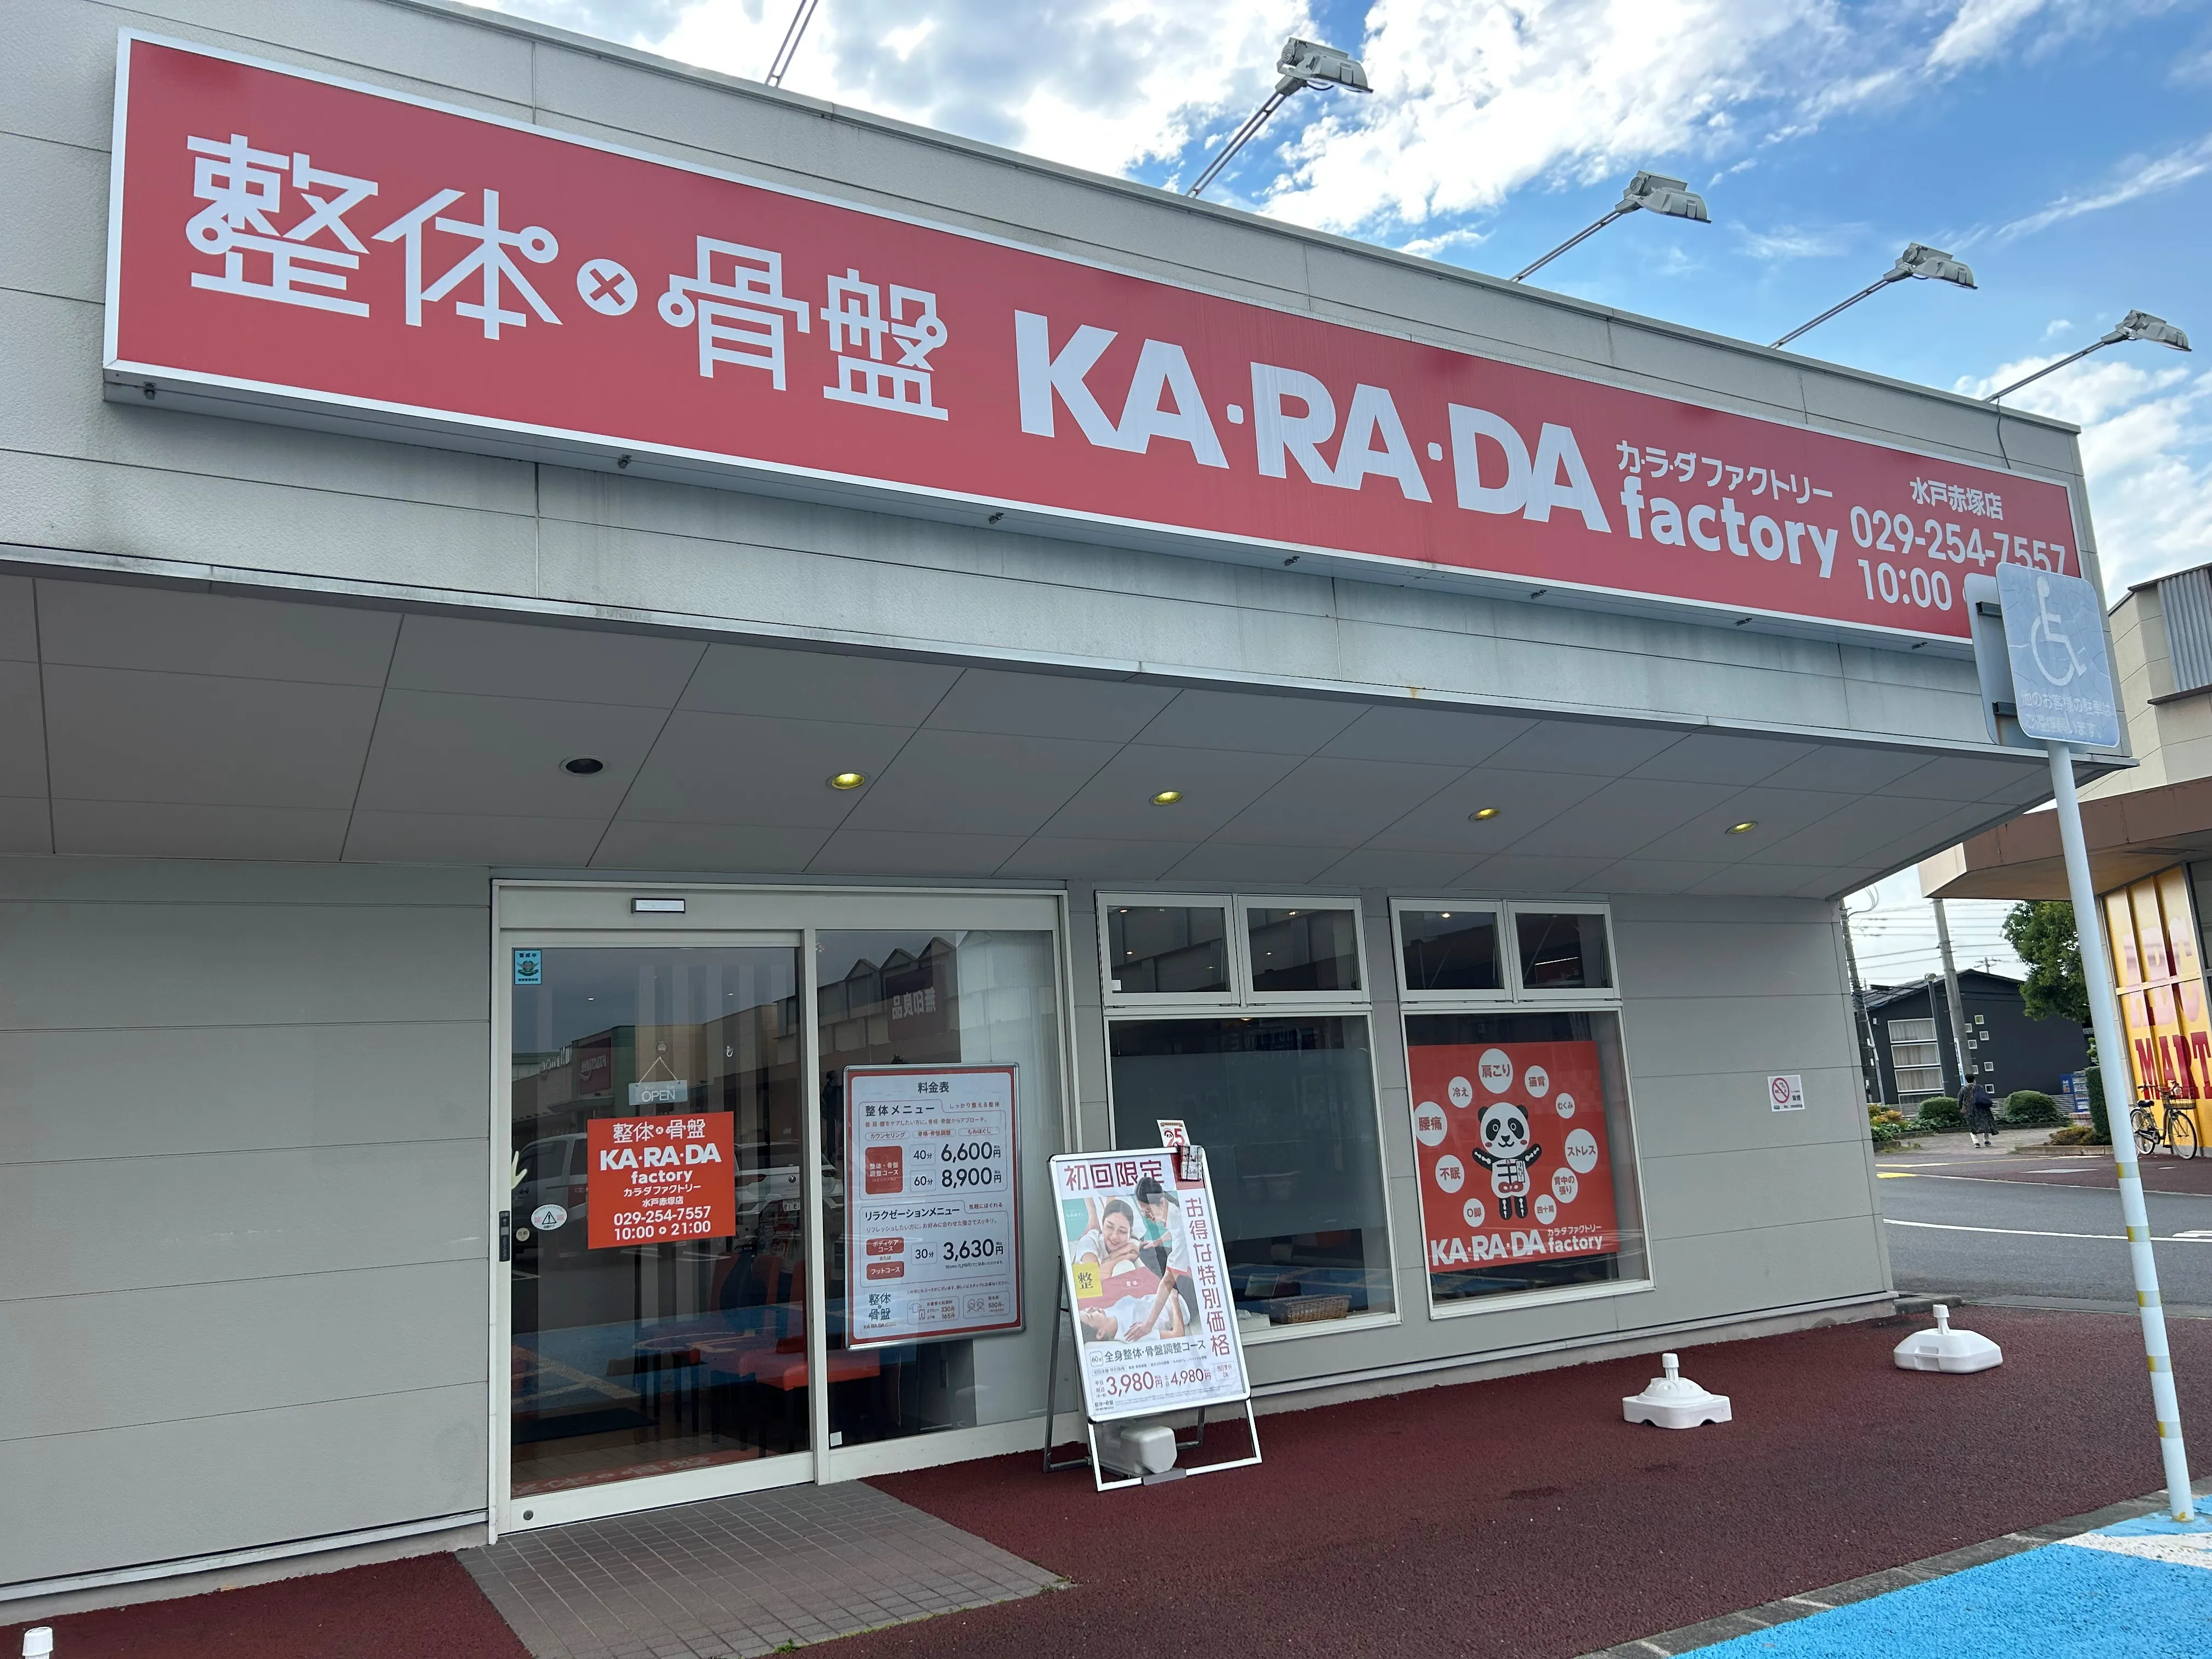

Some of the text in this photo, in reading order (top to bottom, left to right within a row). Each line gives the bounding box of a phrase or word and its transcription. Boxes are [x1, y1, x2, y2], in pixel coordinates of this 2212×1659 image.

[1910, 477, 2003, 521] 水戸赤塚店
[1620, 476, 1838, 579] factory
[1850, 506, 2066, 574] 029-254-7557
[1858, 558, 1952, 611] 10:00
[1481, 1064, 1510, 1077] 肩こり
[2135, 1031, 2212, 1100] MART
[917, 1081, 950, 1093] 料金表
[1528, 1076, 1545, 1087] 猫背
[641, 1089, 675, 1102] OPEN
[1453, 1087, 1469, 1097] 冷え
[865, 1104, 935, 1116] 整体メニュー
[1557, 1102, 1573, 1110] むくみ
[1418, 1116, 1442, 1131] 腰痛
[913, 1150, 932, 1159] 40分
[941, 1142, 1001, 1163] 6,600円
[1567, 1145, 1596, 1156] ストレス
[631, 1170, 693, 1184] factory
[914, 1176, 933, 1186] 60分
[942, 1167, 1001, 1188] 8,900円
[1064, 1160, 1164, 1191] 初回限定
[1440, 1167, 1461, 1181] 不眠
[1554, 1175, 1575, 1186] 背中の
[1559, 1185, 1572, 1195] 張り
[642, 1196, 684, 1207] 水戸赤塚店
[614, 1206, 711, 1226] 029-254-7557
[865, 1207, 960, 1221] リラクゼーションメニュー
[1537, 1205, 1554, 1214] 四十肩
[614, 1220, 711, 1241] 10:00 21:00
[943, 1238, 1003, 1261] 3,630円
[1547, 1235, 1603, 1254] factory
[916, 1249, 934, 1259] 30分
[871, 1266, 900, 1274] フットコース
[1185, 1197, 1230, 1357] お得な特別価格
[1077, 1272, 1093, 1289] 整
[1106, 1371, 1163, 1397] 3,980円
